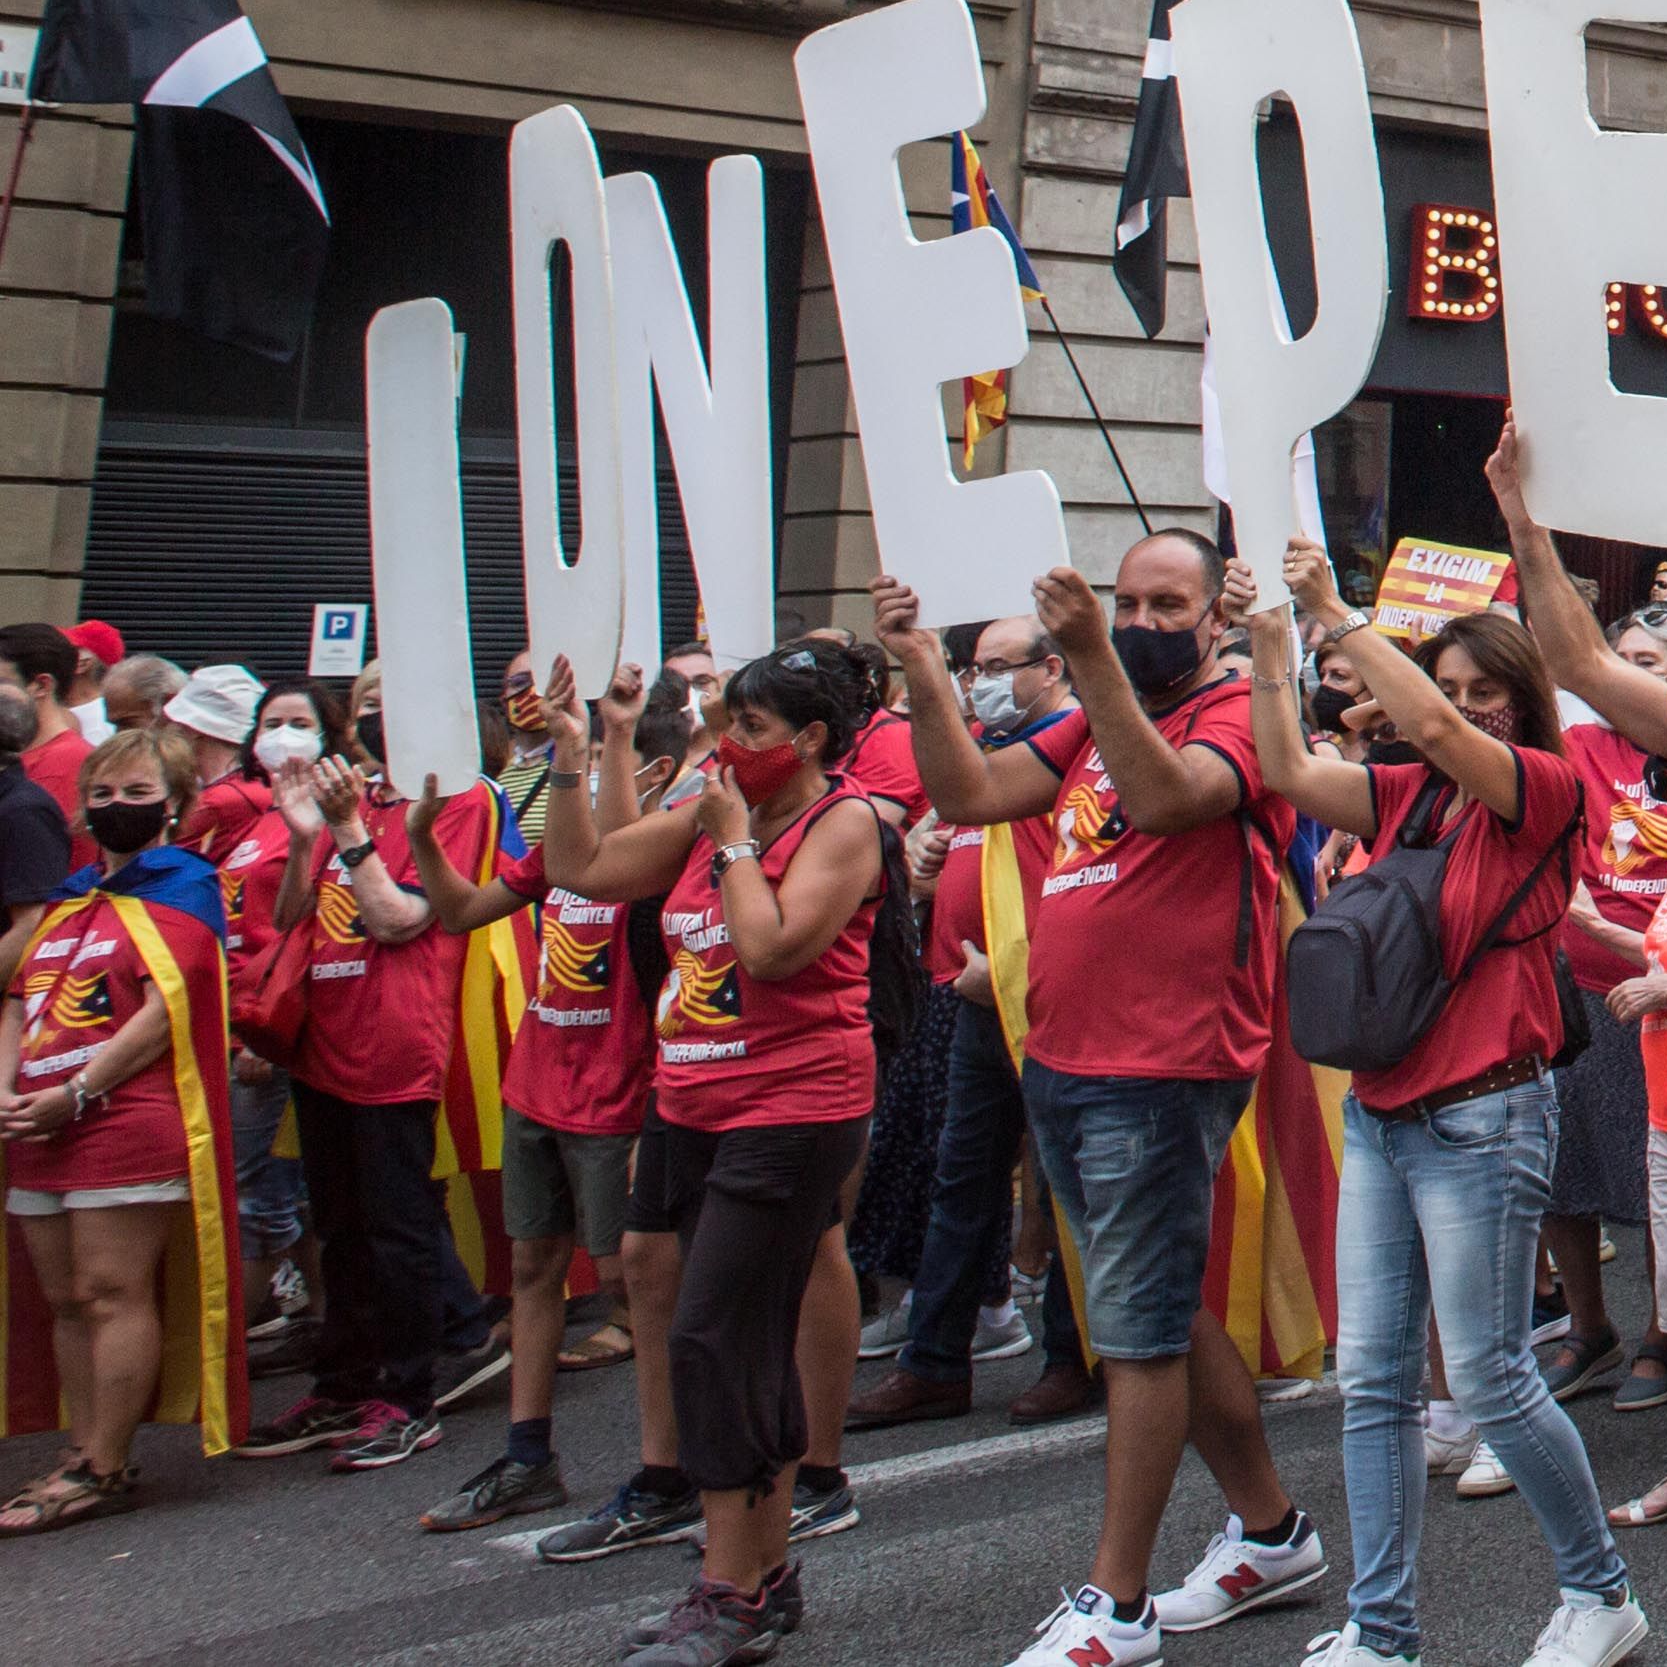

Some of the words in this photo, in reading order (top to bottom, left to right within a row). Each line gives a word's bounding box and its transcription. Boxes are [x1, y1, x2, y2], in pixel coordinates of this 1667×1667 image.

[1404, 546, 1493, 585] EXIGIM
[1424, 580, 1446, 604] LA
[681, 923, 729, 954] GUANYE
